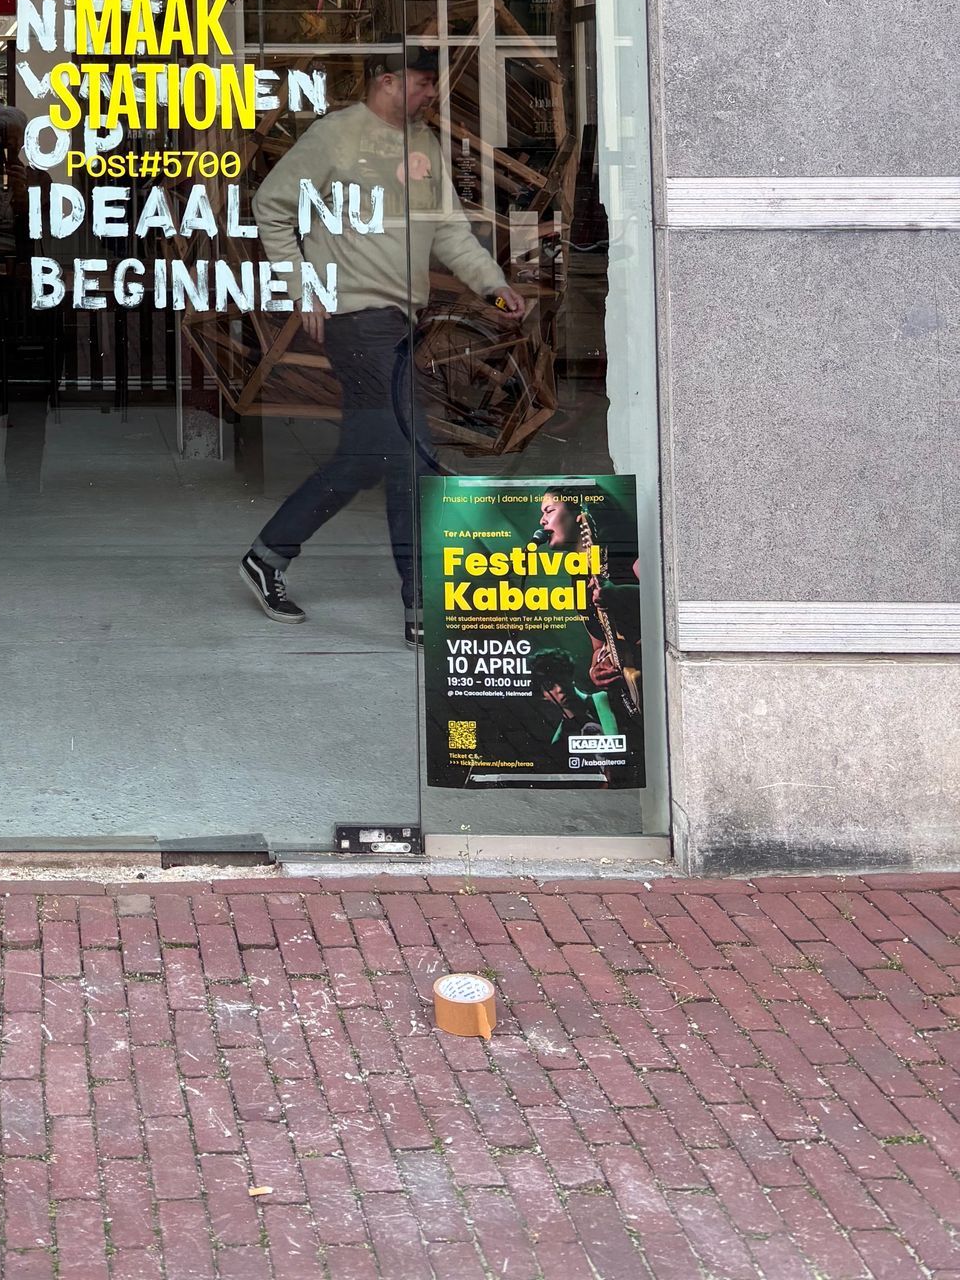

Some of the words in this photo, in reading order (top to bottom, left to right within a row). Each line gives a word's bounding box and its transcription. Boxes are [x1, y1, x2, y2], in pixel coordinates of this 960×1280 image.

[49, 62, 256, 130] STATION
[22, 113, 124, 171] OP
[67, 150, 241, 178] Post#5700
[27, 183, 260, 240] IDEAAL
[297, 178, 386, 240] NU
[29, 256, 339, 313] BEGINNEN
[442, 494, 468, 503] music
[474, 494, 496, 505] party
[502, 494, 528, 503] dance
[560, 494, 579, 504] long
[584, 495, 605, 504] expo
[443, 530, 458, 538] Ter
[459, 530, 471, 538] AA
[472, 530, 512, 540] presents:
[443, 542, 601, 576] Festival
[444, 580, 587, 611] Kabaal
[461, 623, 478, 631] goed
[446, 639, 532, 656] VRIJDAG
[446, 656, 469, 675] 10
[474, 657, 532, 675] APRIL
[447, 677, 474, 687] 19:30
[484, 677, 511, 688] 01:00
[513, 679, 532, 687] uur
[571, 738, 624, 750] KABAAL
[448, 752, 467, 760] Ticket
